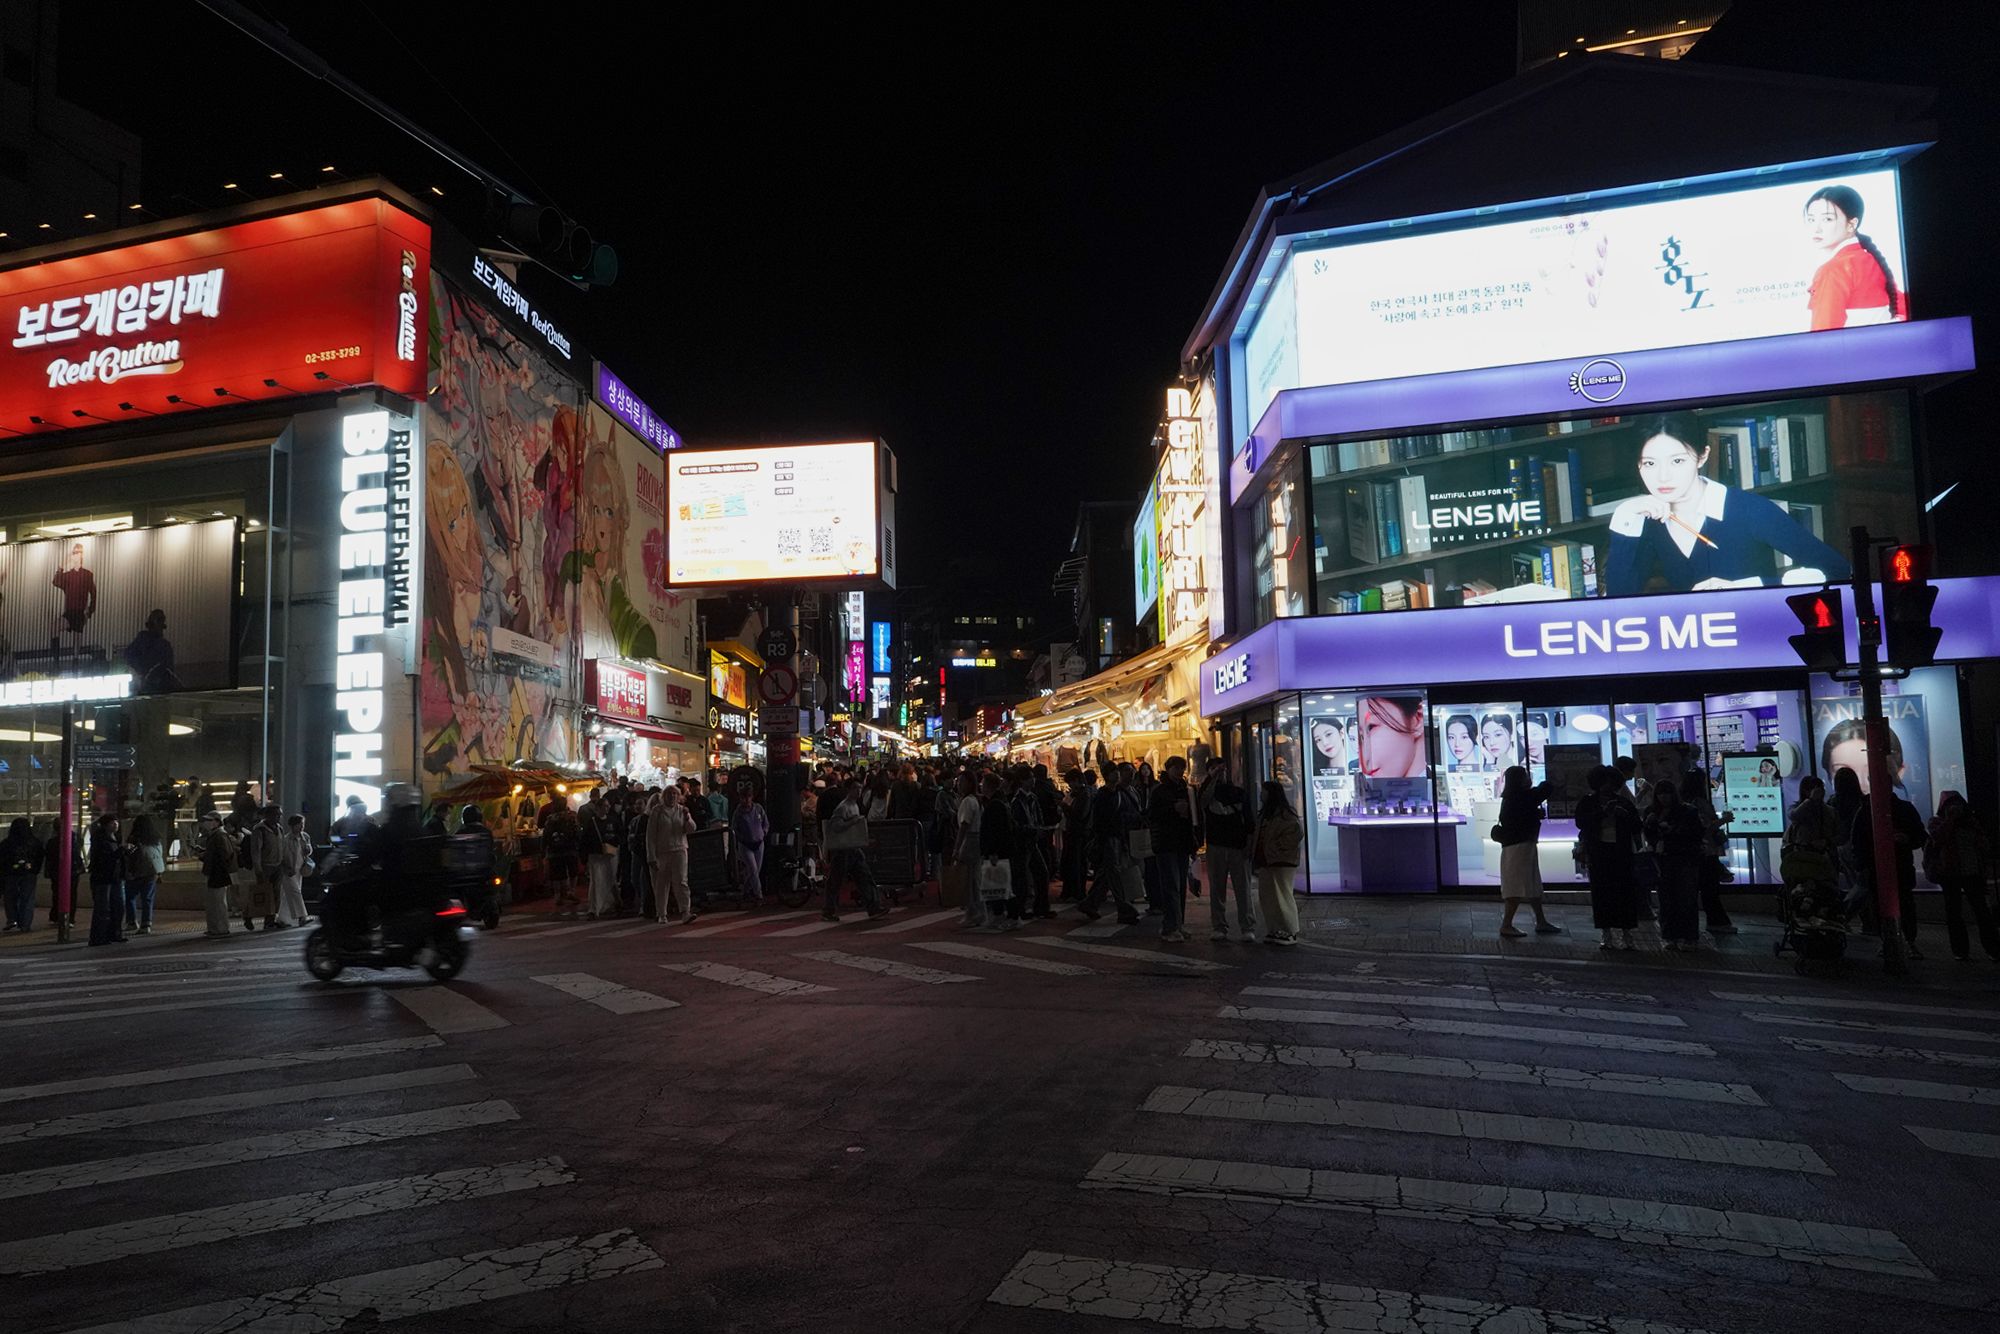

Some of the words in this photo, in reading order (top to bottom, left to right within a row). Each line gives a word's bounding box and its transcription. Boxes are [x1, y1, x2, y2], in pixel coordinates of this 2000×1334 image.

[12, 267, 226, 349] 보드게임카페
[471, 255, 529, 323] 보드게임카페
[1369, 297, 1391, 312] 한국
[1395, 293, 1428, 309] 연극사
[1432, 290, 1455, 304] 최대
[1457, 287, 1481, 302] 관객
[1483, 283, 1506, 299] 동원
[1509, 281, 1532, 294] 작품
[1500, 297, 1524, 311] 원작
[608, 379, 641, 426] 상상의문
[339, 411, 390, 570] BLUE
[1430, 491, 1466, 501] BEAUTIFUL
[1468, 490, 1486, 499] LENS
[1488, 489, 1501, 497] FOR
[1171, 491, 1198, 621] AURA
[767, 643, 787, 657] R3
[832, 713, 852, 722] MBC
